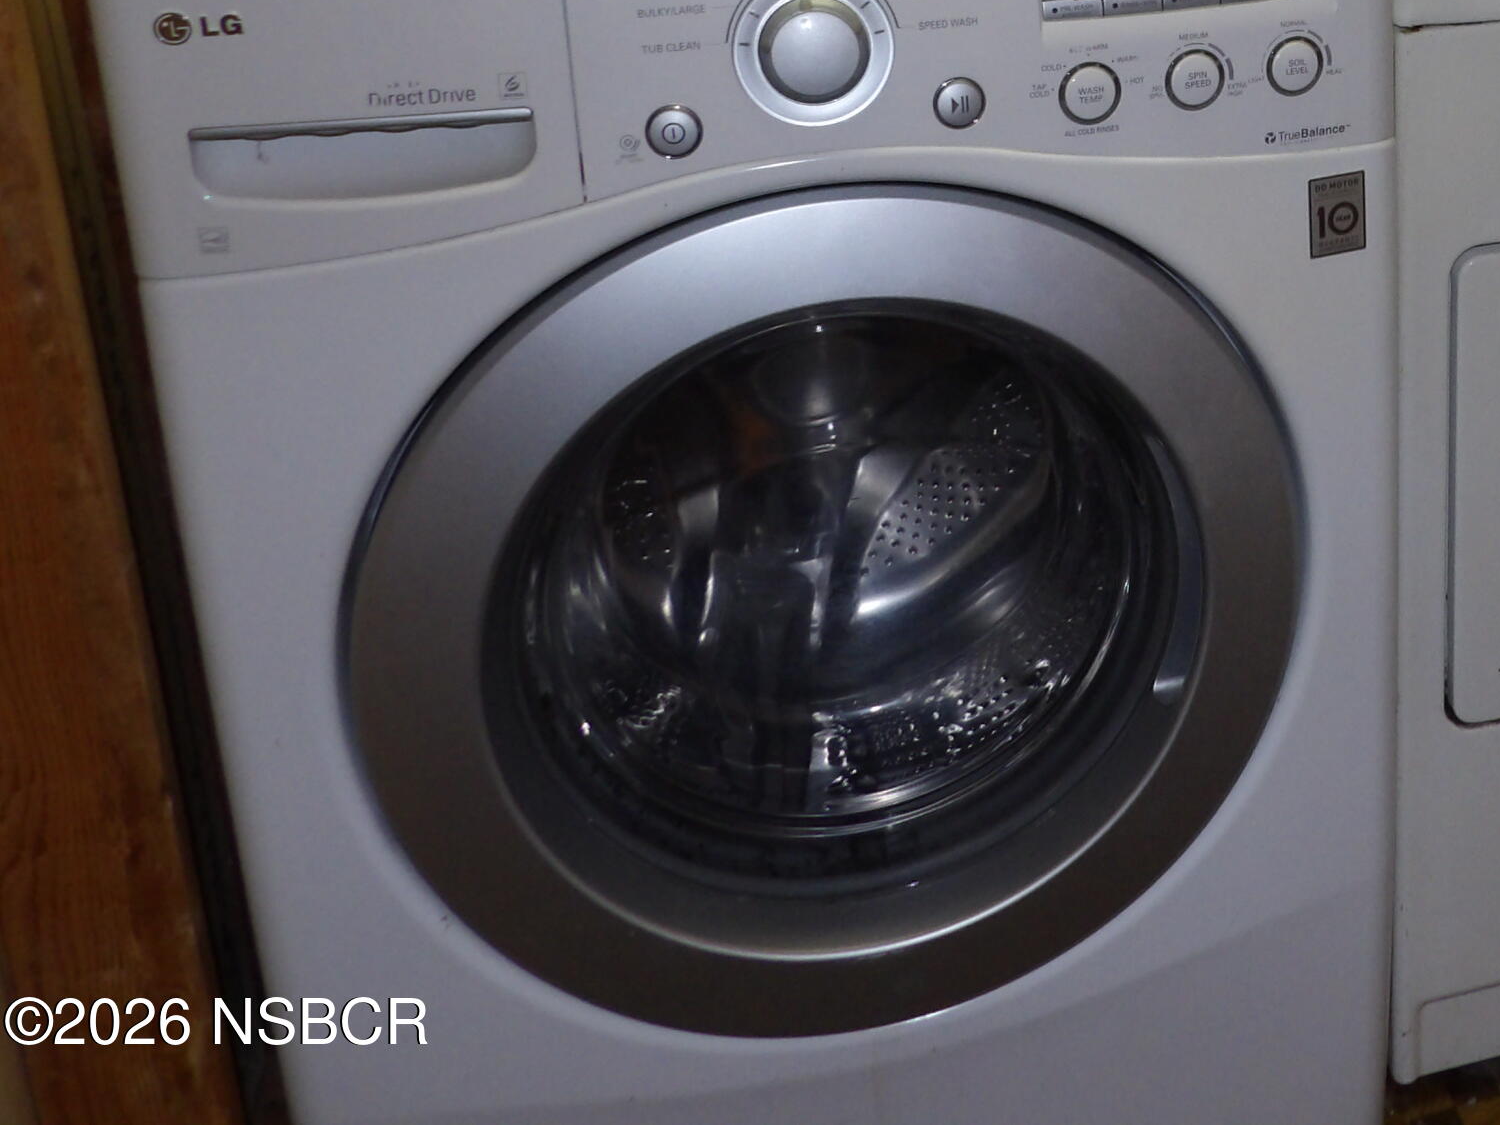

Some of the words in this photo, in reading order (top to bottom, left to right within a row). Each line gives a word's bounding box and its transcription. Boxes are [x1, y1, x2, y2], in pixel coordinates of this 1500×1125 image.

[636, 4, 705, 19] BULKY/LARGE
[200, 14, 245, 37] LG
[918, 19, 947, 31] SPEED
[950, 17, 978, 29] WASH
[641, 44, 663, 55] TUB
[665, 40, 701, 52] CLEAN
[1041, 63, 1063, 73] COLD
[1288, 59, 1307, 68] SOIL
[1188, 71, 1207, 81] SPIN
[1285, 66, 1309, 76] LEVEL
[1130, 76, 1144, 84] HOT
[1184, 78, 1212, 89] SPEED
[428, 88, 477, 105] Drive
[1029, 90, 1050, 99] COLD
[1078, 86, 1104, 96] WASH
[1079, 94, 1103, 104] TEMP
[1077, 127, 1096, 136] COLD
[1096, 124, 1120, 134] RINSES
[1328, 178, 1359, 190] MOTOR
[1317, 201, 1360, 239] 10
